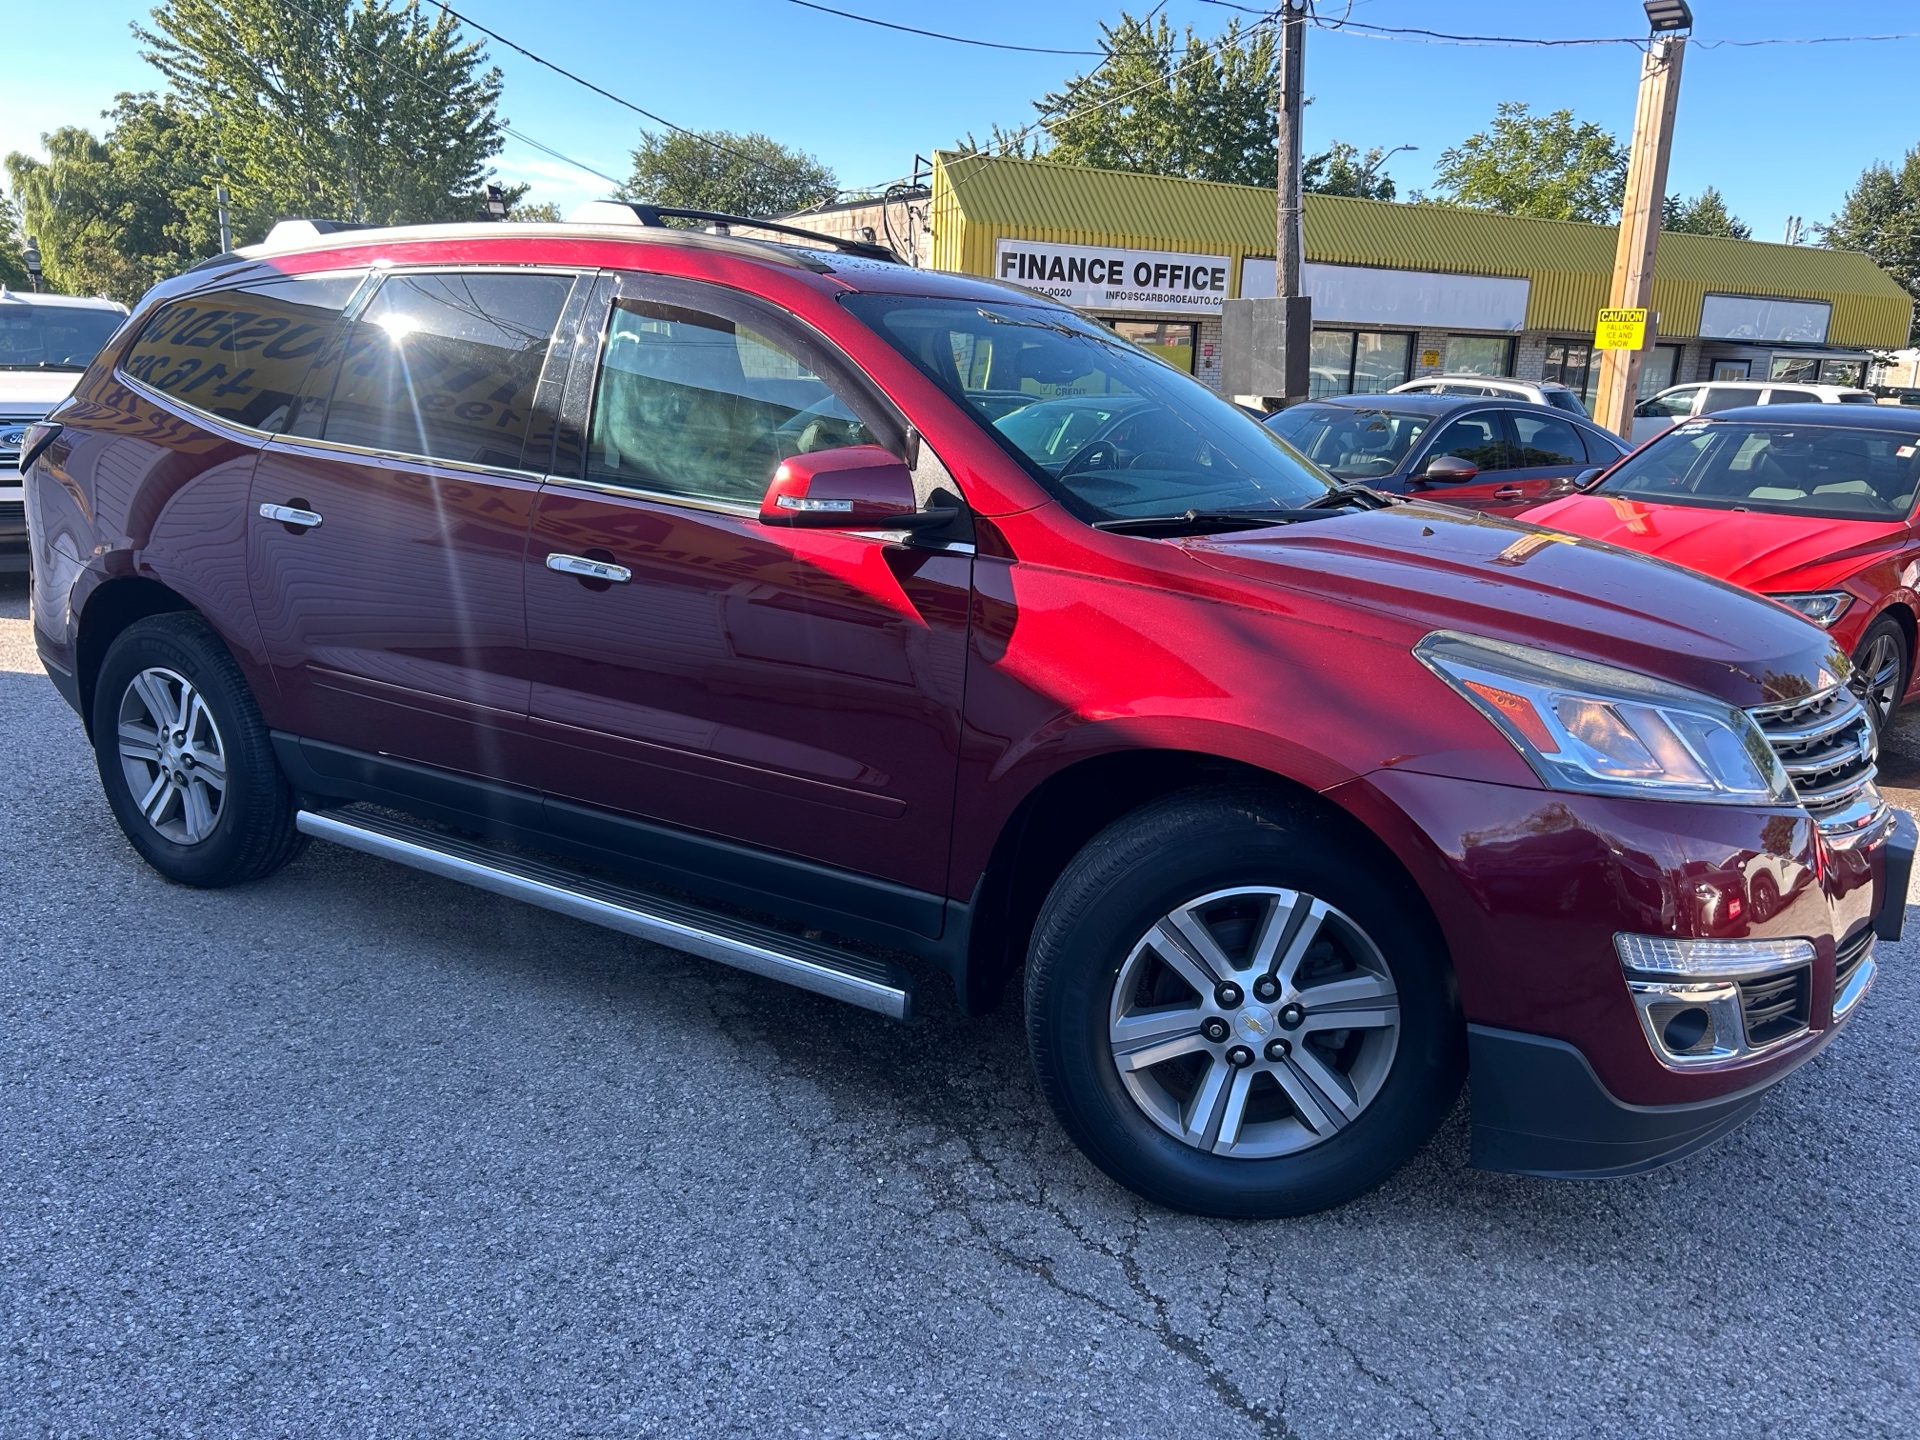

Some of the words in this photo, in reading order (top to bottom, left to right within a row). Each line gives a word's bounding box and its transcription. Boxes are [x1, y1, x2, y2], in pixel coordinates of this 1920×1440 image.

[1001, 252, 1124, 285] FINANCE
[1133, 261, 1225, 290] OFFICE
[1028, 287, 1072, 297] 7-0020
[1601, 311, 1643, 322] CAUTION
[1606, 323, 1634, 331] FALLING
[1055, 387, 1087, 397] CREDIT
